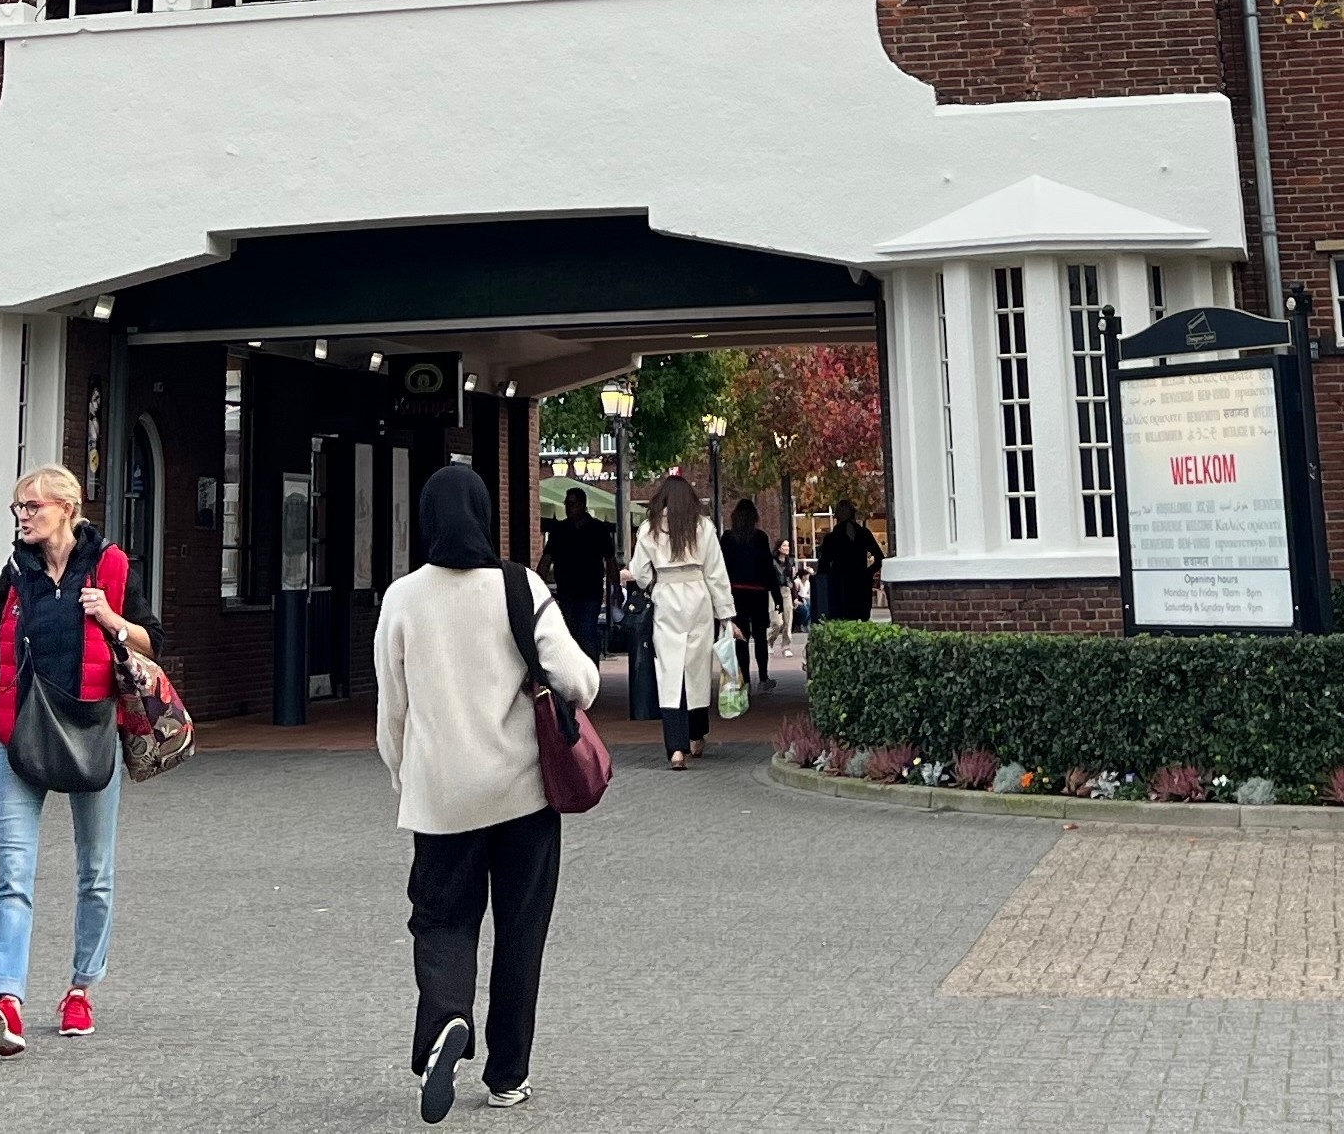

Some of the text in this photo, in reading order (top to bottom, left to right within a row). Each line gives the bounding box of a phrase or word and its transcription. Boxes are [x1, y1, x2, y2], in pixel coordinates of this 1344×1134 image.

[1170, 453, 1237, 485] WELKOM
[1184, 574, 1238, 587] Opening hours
[1164, 588, 1189, 598] Monday
[1190, 589, 1198, 597] to
[1199, 588, 1218, 598] Friday
[1164, 603, 1192, 613] Saturday
[1200, 603, 1224, 613] Sunday
